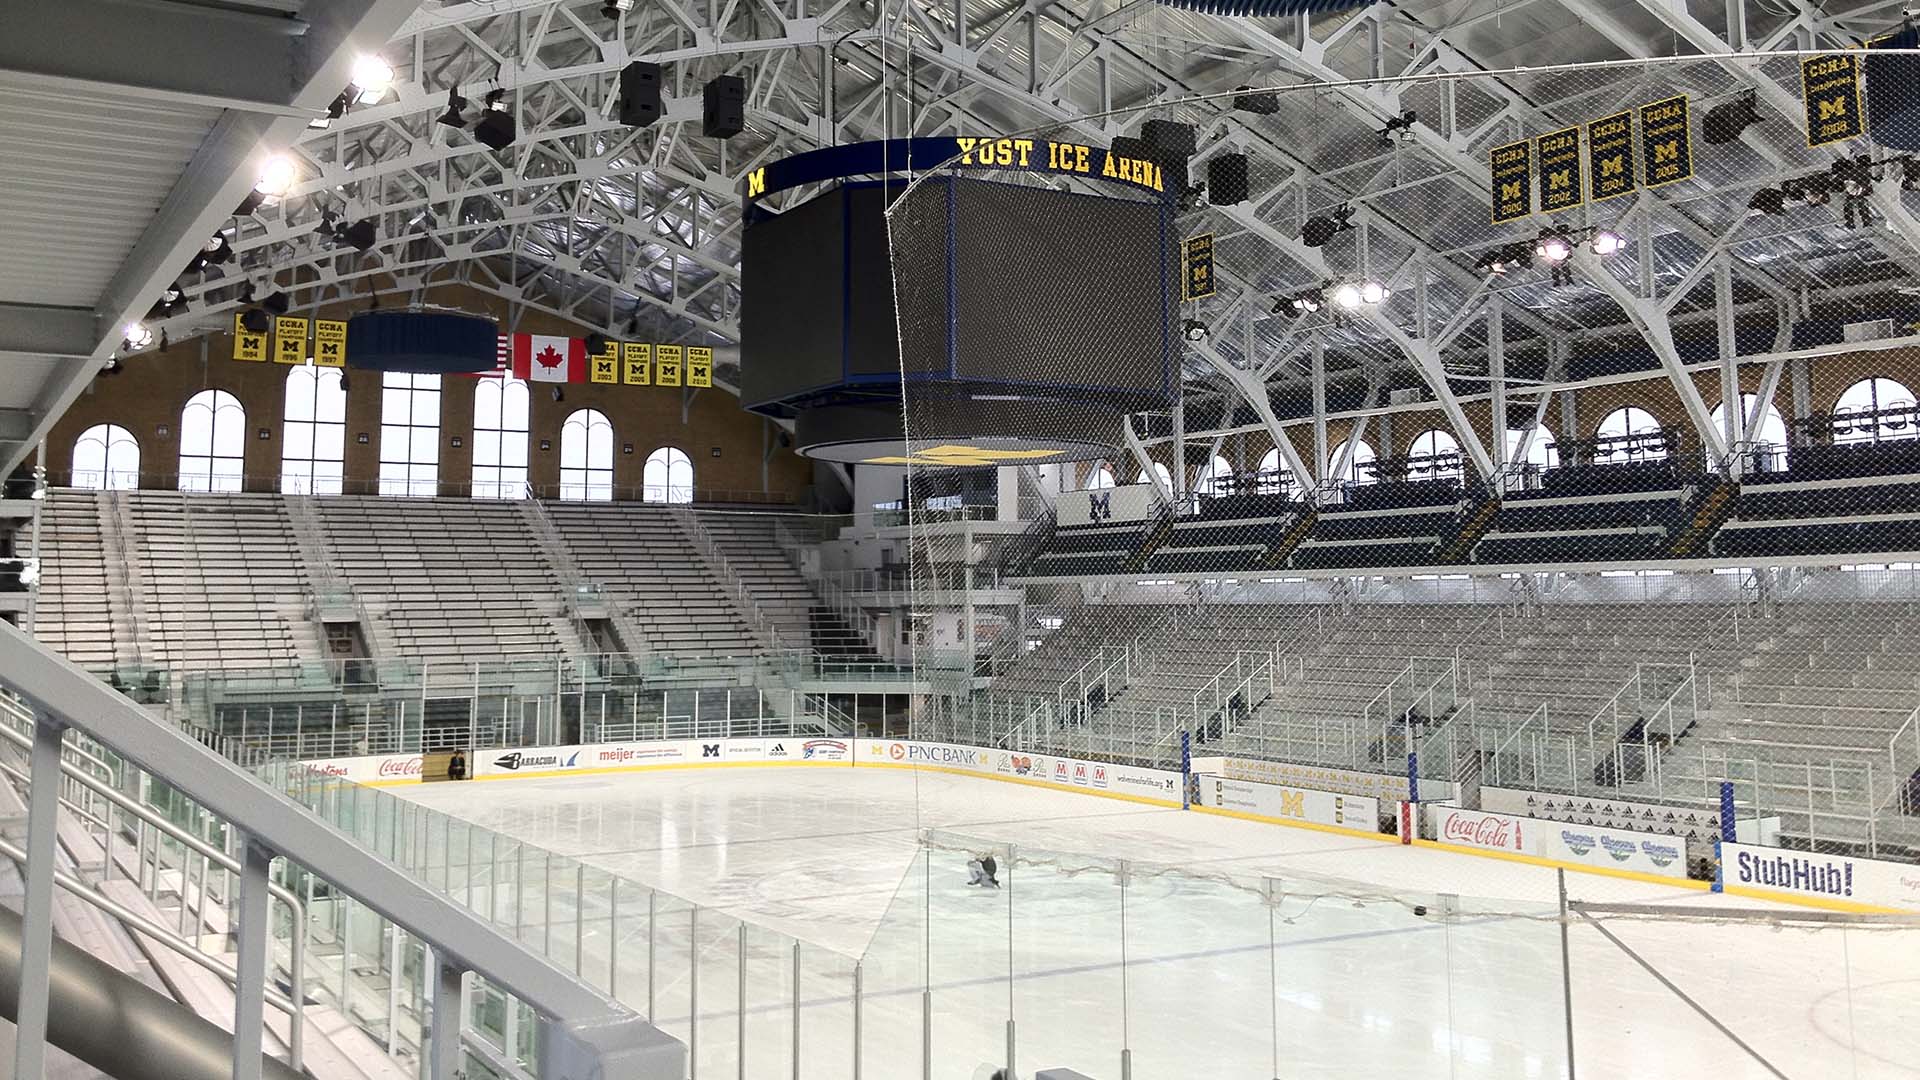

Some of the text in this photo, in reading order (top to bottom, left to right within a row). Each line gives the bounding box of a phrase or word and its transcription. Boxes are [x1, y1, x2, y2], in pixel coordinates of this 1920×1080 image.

[1808, 57, 1850, 78] CCHA
[1646, 104, 1682, 124] CCHA
[1818, 95, 1846, 121] M
[1594, 120, 1626, 138] CCHA
[1542, 135, 1574, 153] CCHA
[1654, 139, 1678, 163] M
[956, 137, 1165, 192] YOST ICE ARENA
[1601, 153, 1623, 177] M
[748, 167, 765, 197] M
[1549, 168, 1570, 190] M
[1501, 179, 1521, 201] M
[1193, 264, 1207, 281] M
[279, 320, 305, 329] CCHA
[318, 322, 343, 332] CCHA
[242, 337, 259, 349] M
[282, 340, 299, 352] M
[321, 343, 338, 355] M
[627, 345, 648, 353] CCHA
[659, 347, 679, 355] CCHA
[689, 348, 709, 356] CCHA
[597, 362, 611, 372] M
[631, 364, 645, 374] M
[662, 365, 676, 376] M
[693, 366, 707, 377] M
[1089, 491, 1111, 520] M
[600, 747, 635, 763] meijer
[702, 744, 720, 757] M
[908, 745, 941, 761] PNC
[942, 747, 977, 765] BANK
[511, 752, 557, 770] BARRACUDA
[1280, 789, 1305, 817] M
[1444, 811, 1511, 849] Coca-Cola
[1738, 851, 1853, 897] StubHub!
